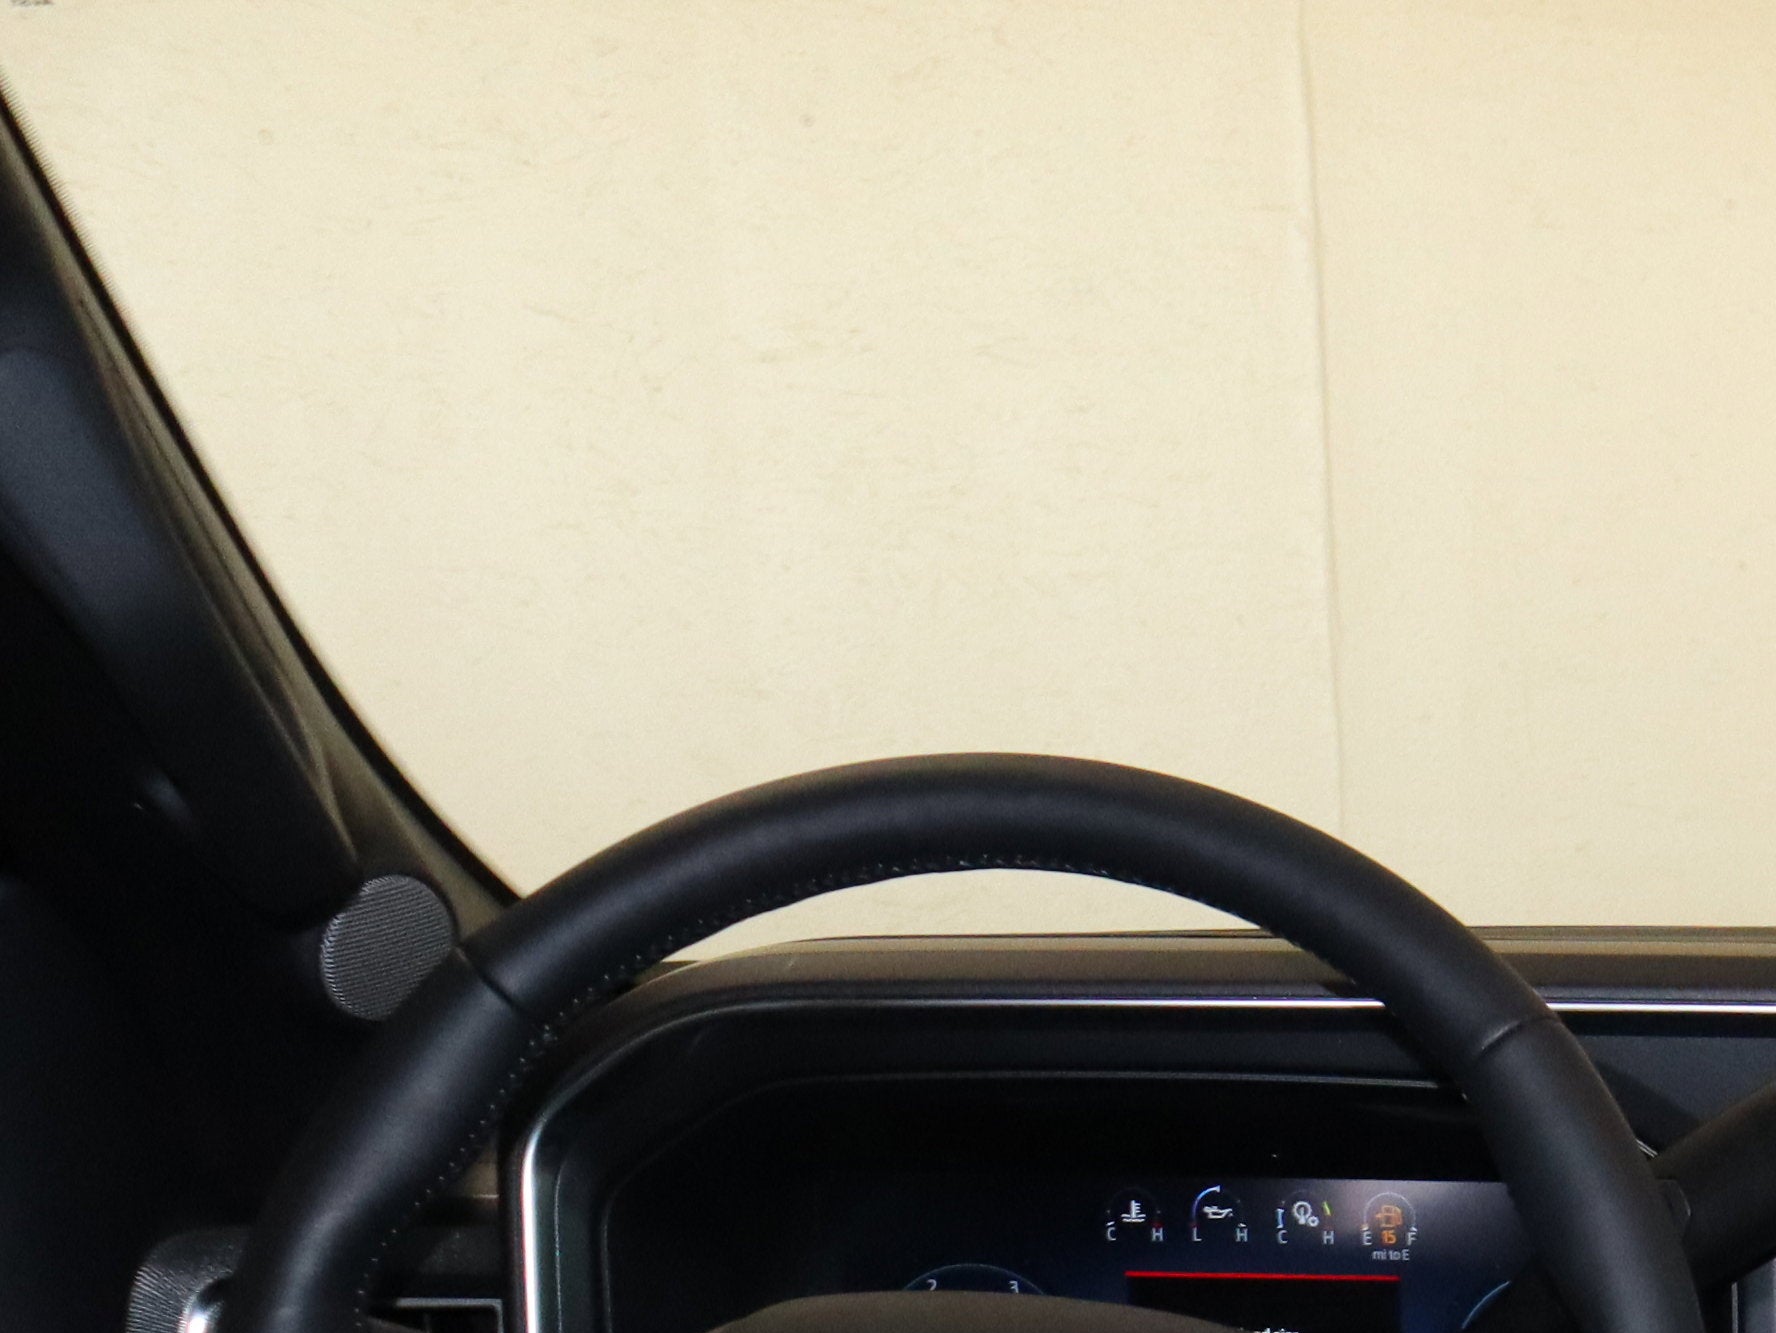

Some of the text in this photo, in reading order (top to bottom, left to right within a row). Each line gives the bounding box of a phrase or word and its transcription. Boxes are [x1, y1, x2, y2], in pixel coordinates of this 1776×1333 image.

[1105, 1227, 1117, 1241] C
[1151, 1227, 1164, 1242] H
[1191, 1227, 1202, 1242] L
[1235, 1227, 1248, 1242] H
[1277, 1230, 1288, 1245] C
[1322, 1230, 1335, 1245] H
[1361, 1231, 1373, 1246] E
[1381, 1230, 1396, 1245] 15
[1406, 1231, 1418, 1246] F
[1401, 1249, 1410, 1261] E
